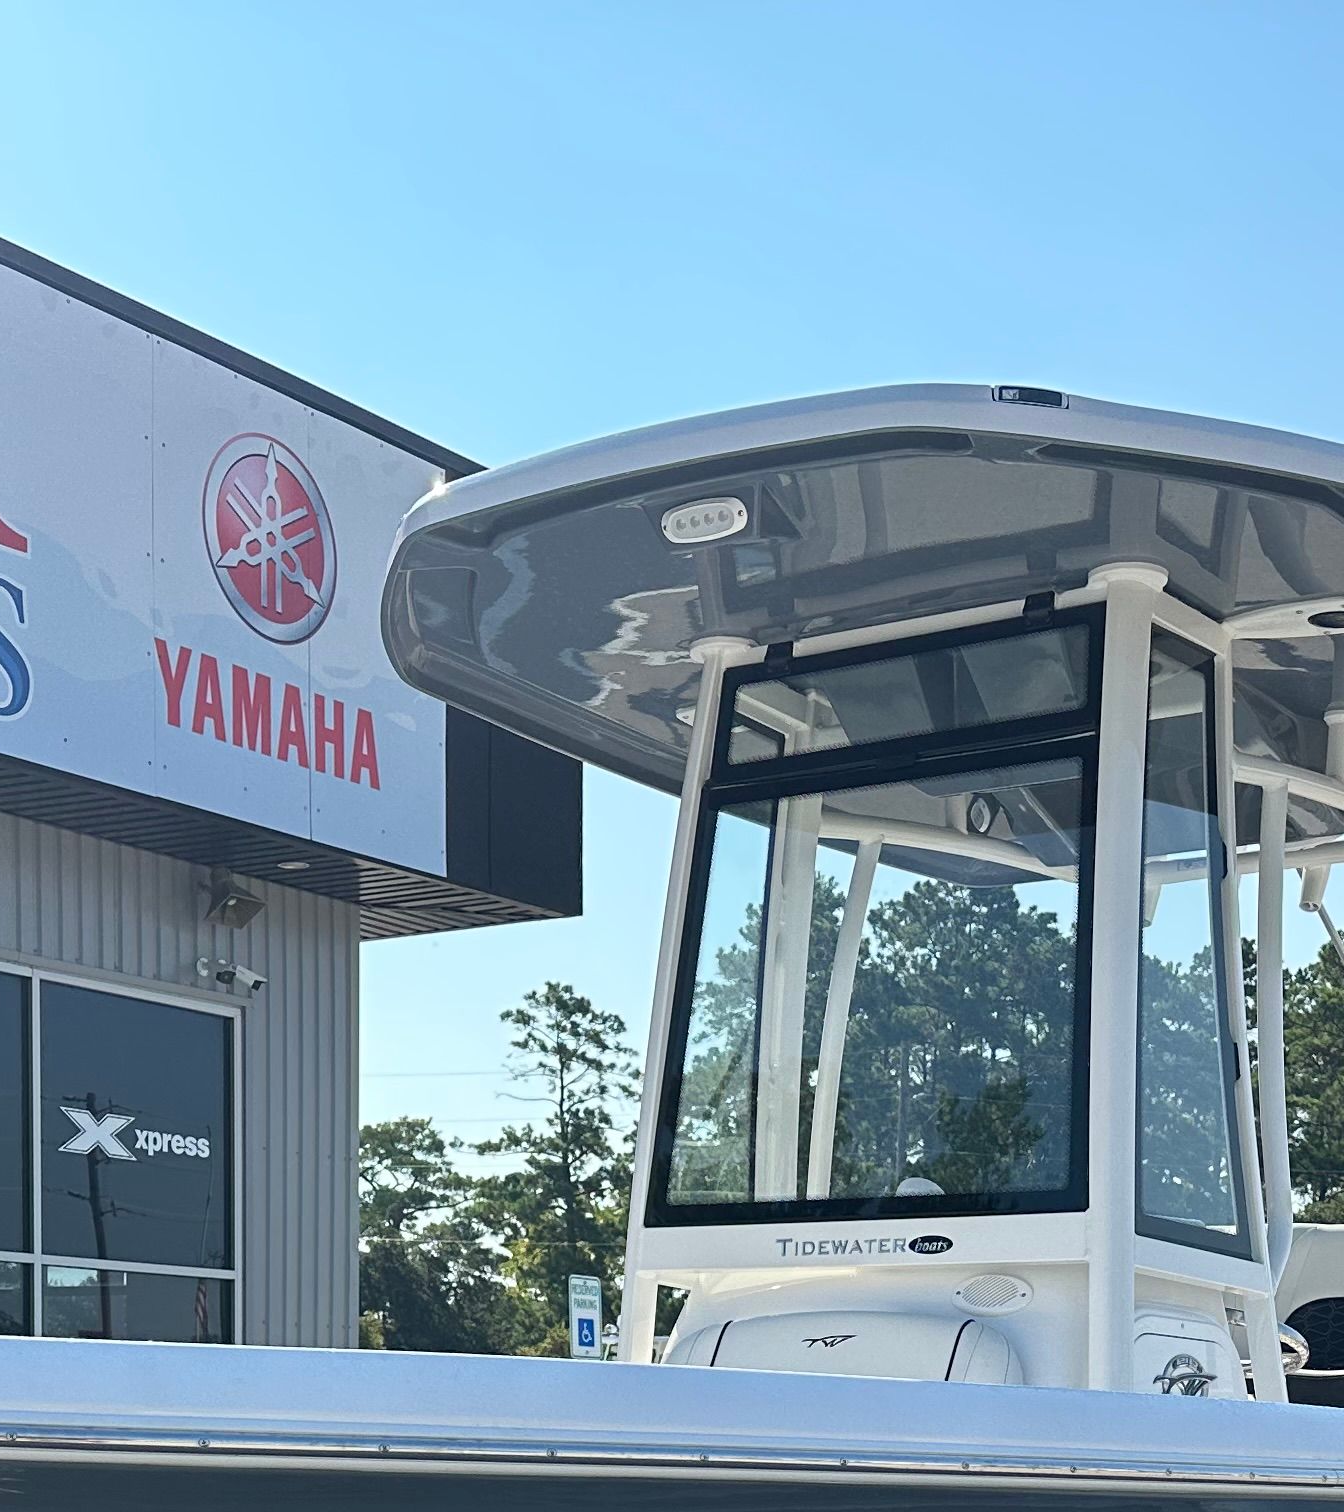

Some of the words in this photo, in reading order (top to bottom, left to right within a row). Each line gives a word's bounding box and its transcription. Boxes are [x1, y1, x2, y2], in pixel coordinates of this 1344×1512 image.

[154, 638, 381, 790] YAMAHA
[134, 1128, 210, 1158] xpress
[776, 1237, 907, 1257] TIDEWATER
[914, 1237, 949, 1254] boats
